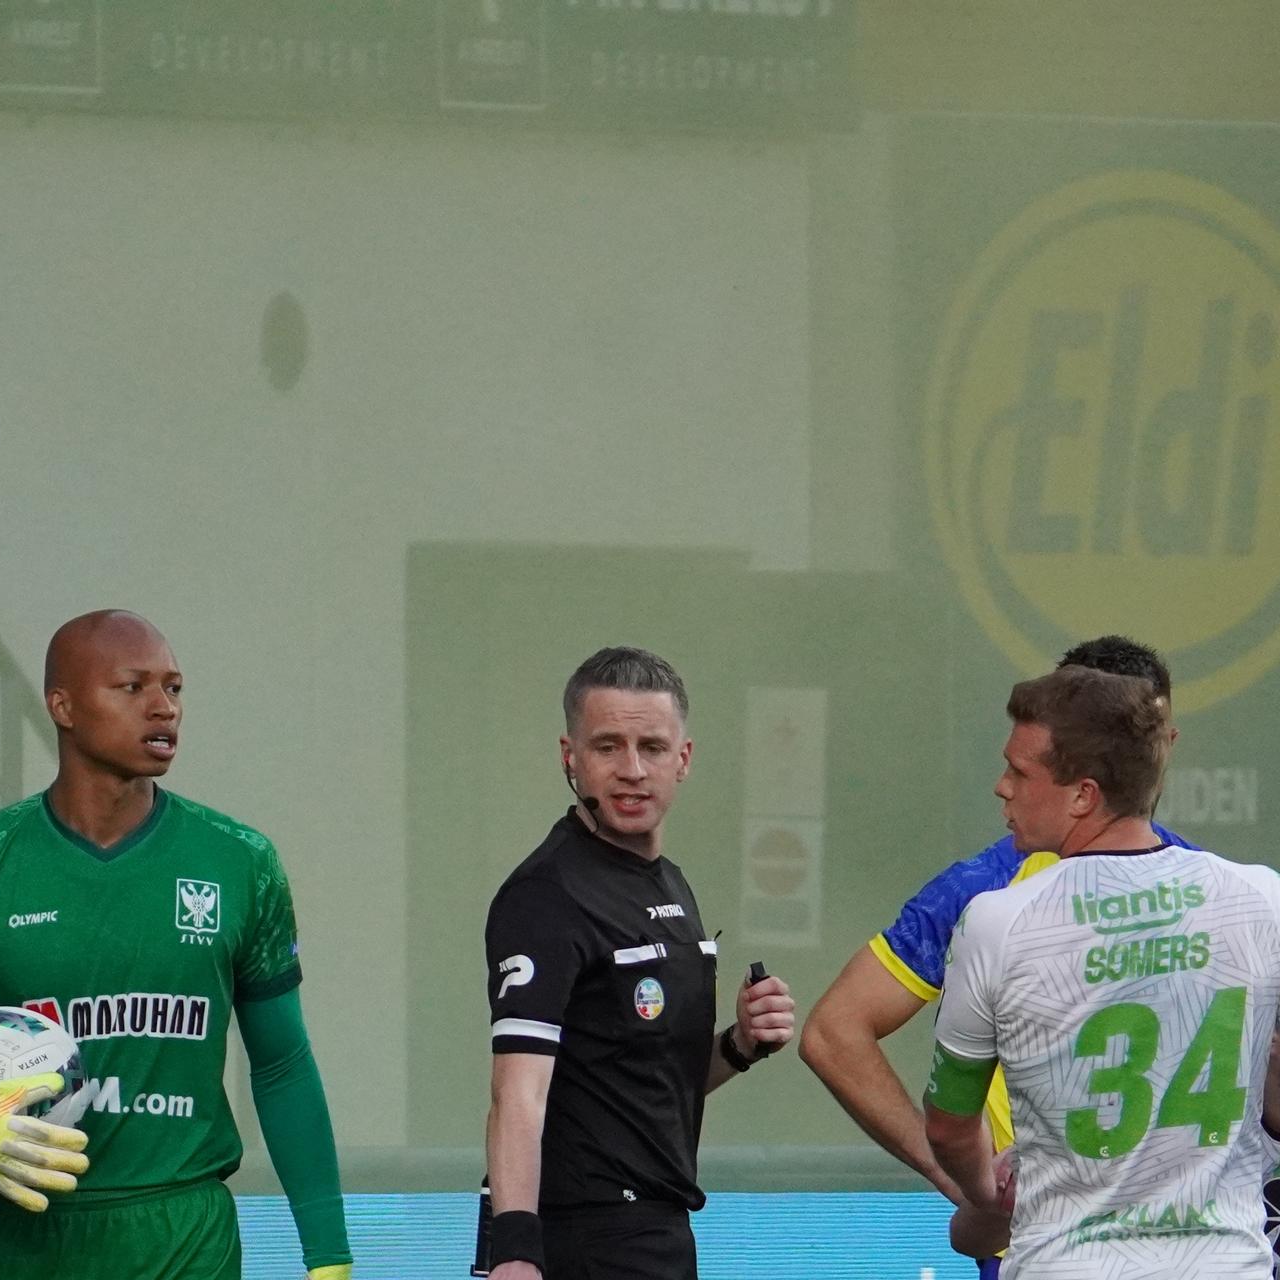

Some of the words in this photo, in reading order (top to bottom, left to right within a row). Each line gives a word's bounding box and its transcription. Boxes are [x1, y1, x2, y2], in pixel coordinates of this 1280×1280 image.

[1005, 283, 1278, 557] Eldi
[8, 910, 59, 928] OLYMPIC
[1071, 877, 1206, 926] liantis
[180, 934, 214, 946] STVV
[1084, 931, 1210, 984] SOMERS
[72, 996, 207, 1039] MARUHAN
[18, 1053, 49, 1071] KIPSTA
[1065, 986, 1248, 1160] 34
